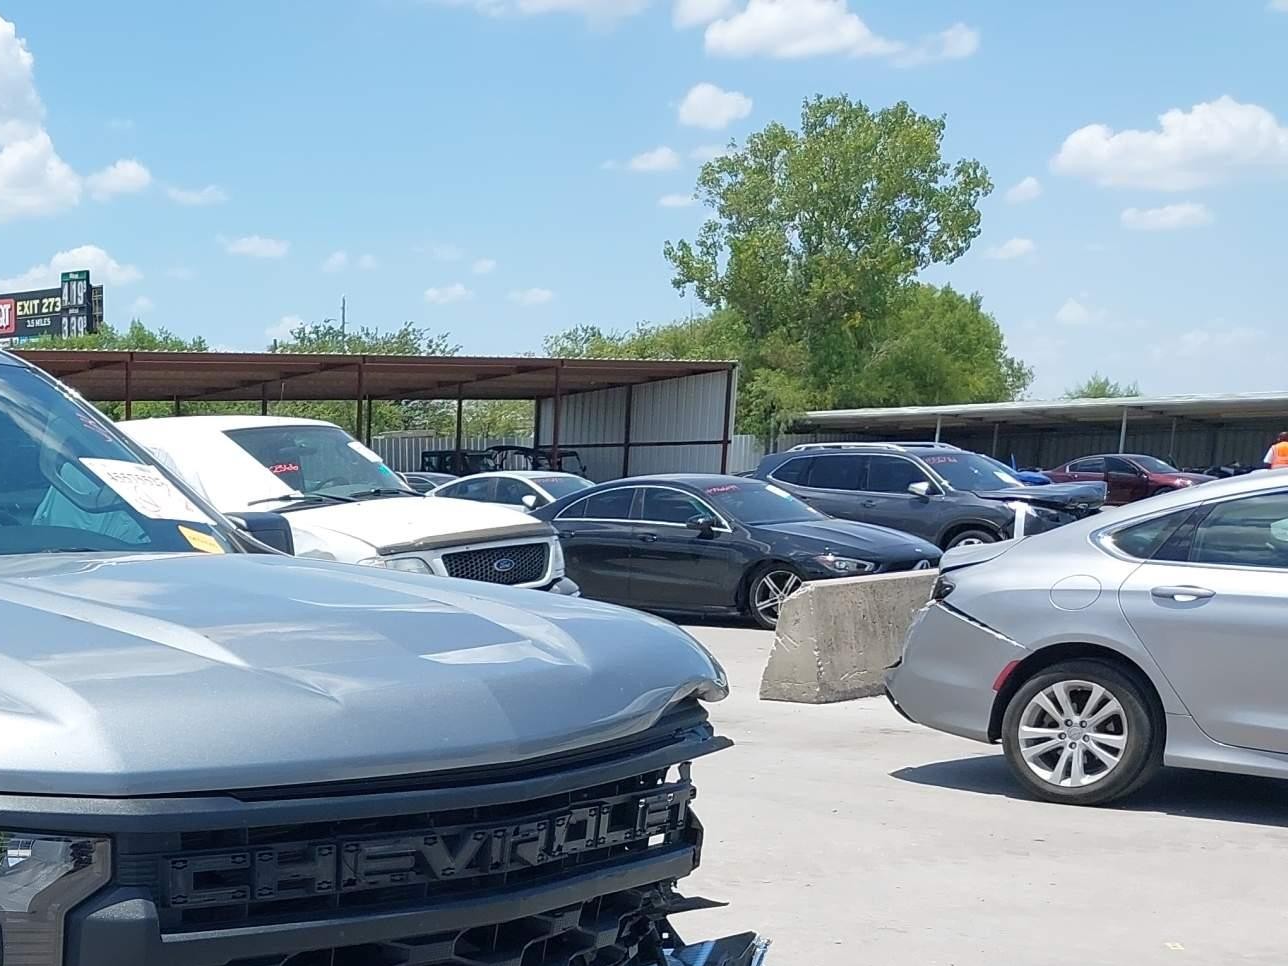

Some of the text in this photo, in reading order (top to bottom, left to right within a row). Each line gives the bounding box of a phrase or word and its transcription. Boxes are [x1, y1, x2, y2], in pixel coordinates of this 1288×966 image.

[16, 297, 62, 316] EXIT 273
[35, 318, 51, 327] MILES
[168, 794, 688, 904] CHEVROLET
